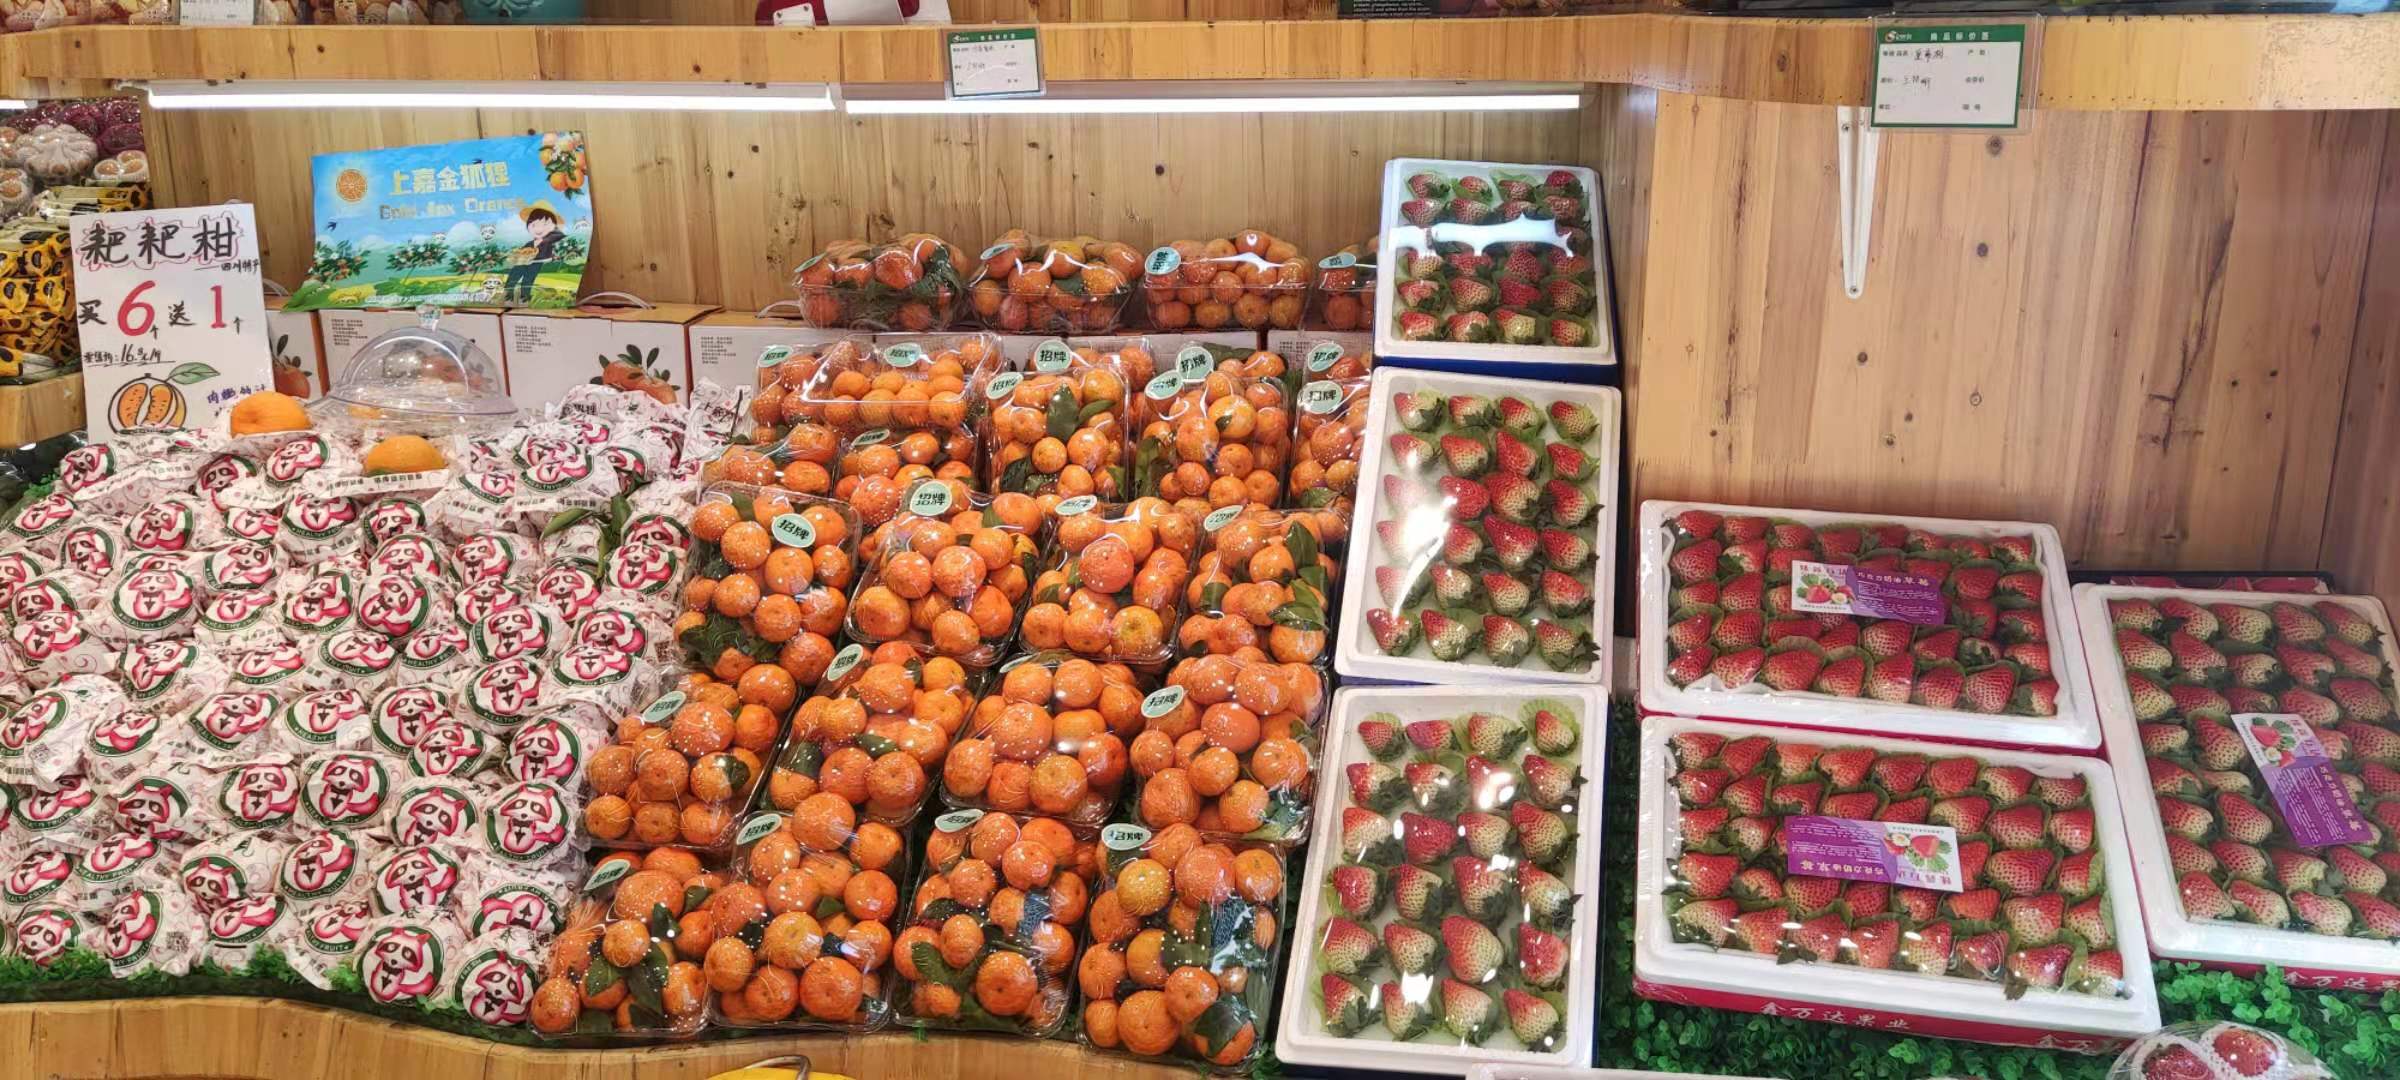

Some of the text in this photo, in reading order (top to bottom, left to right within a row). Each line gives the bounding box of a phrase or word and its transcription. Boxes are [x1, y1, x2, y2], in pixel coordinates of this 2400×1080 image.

[389, 160, 511, 195] 上嘉金狐狸
[1039, 350, 1067, 362] 招牌
[777, 518, 811, 542] 招牌
[1149, 693, 1178, 708] 招牌
